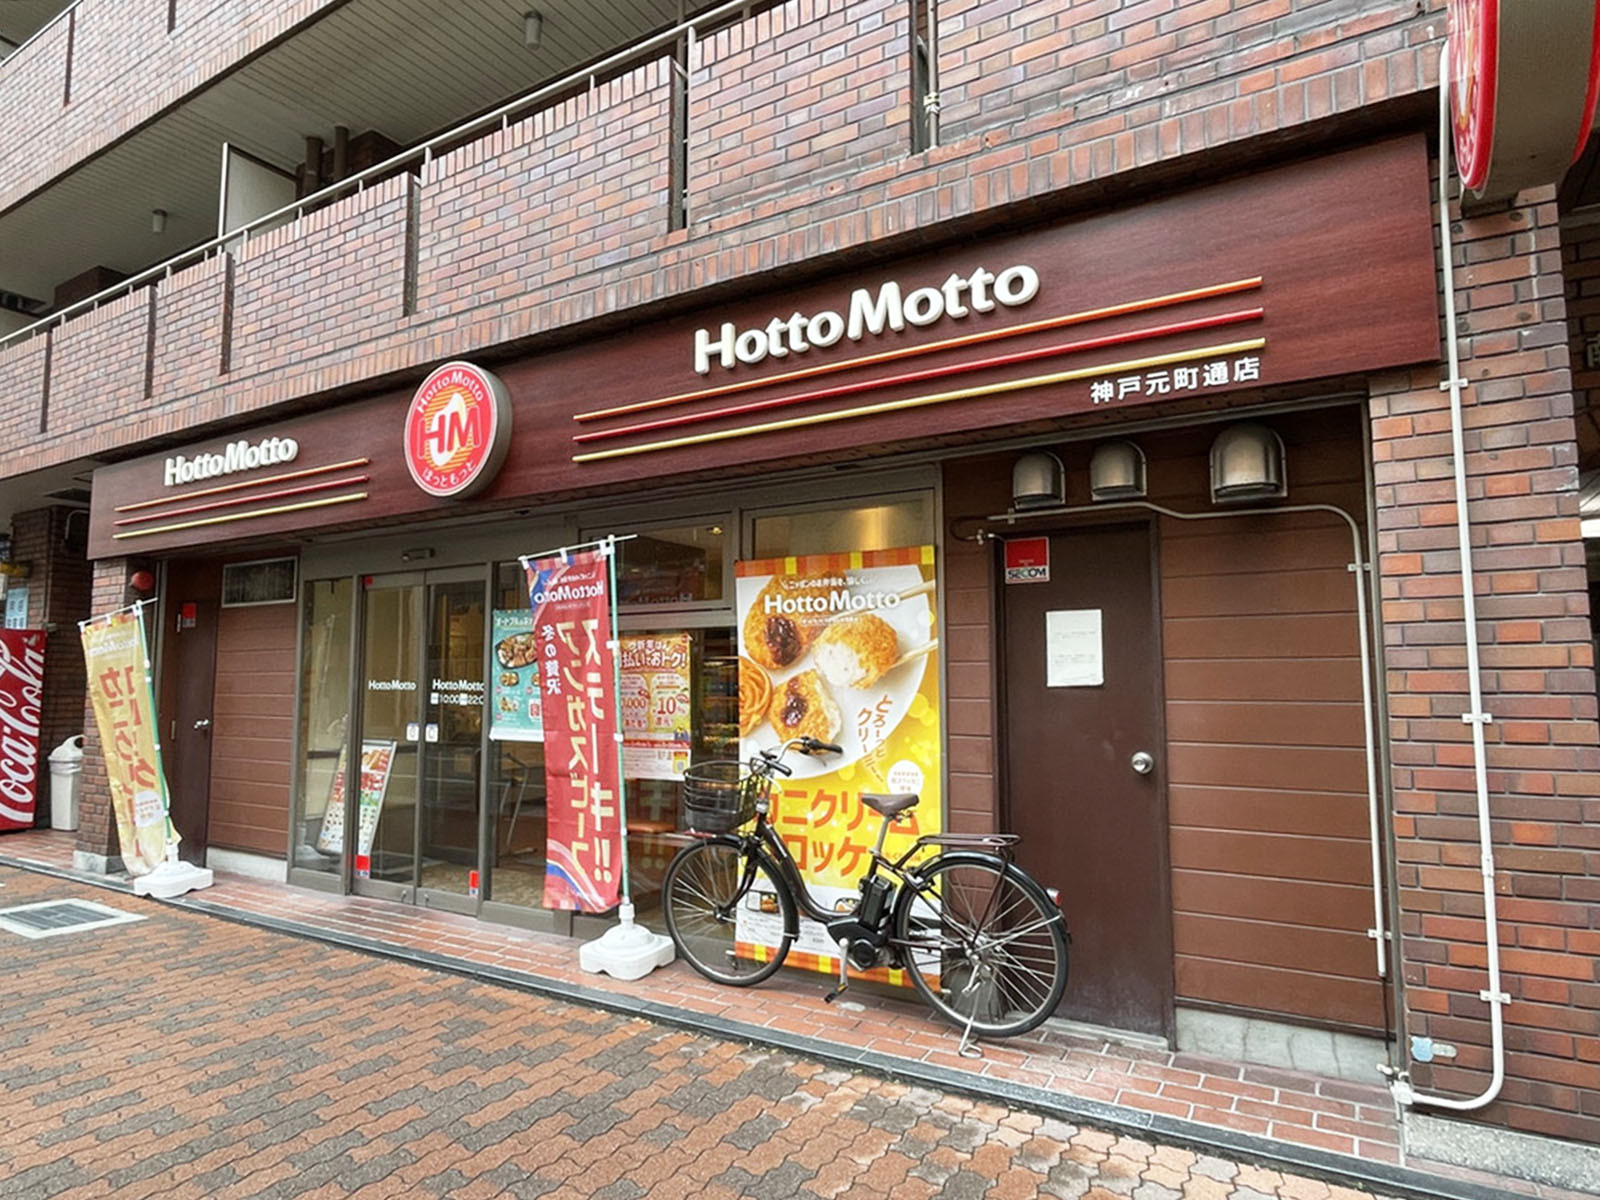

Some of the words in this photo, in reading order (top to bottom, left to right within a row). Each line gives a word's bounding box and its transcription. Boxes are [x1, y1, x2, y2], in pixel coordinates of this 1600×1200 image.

[694, 265, 1040, 374] HottoMotto
[417, 371, 484, 413] HottoMotto
[1090, 357, 1260, 404] 神戸元町通店
[164, 437, 298, 486] HottoMotto
[422, 460, 476, 487] ほっともっと
[764, 590, 900, 614] HottoMotto
[368, 680, 416, 690] HottoMotto
[778, 834, 868, 877] ロッケ
